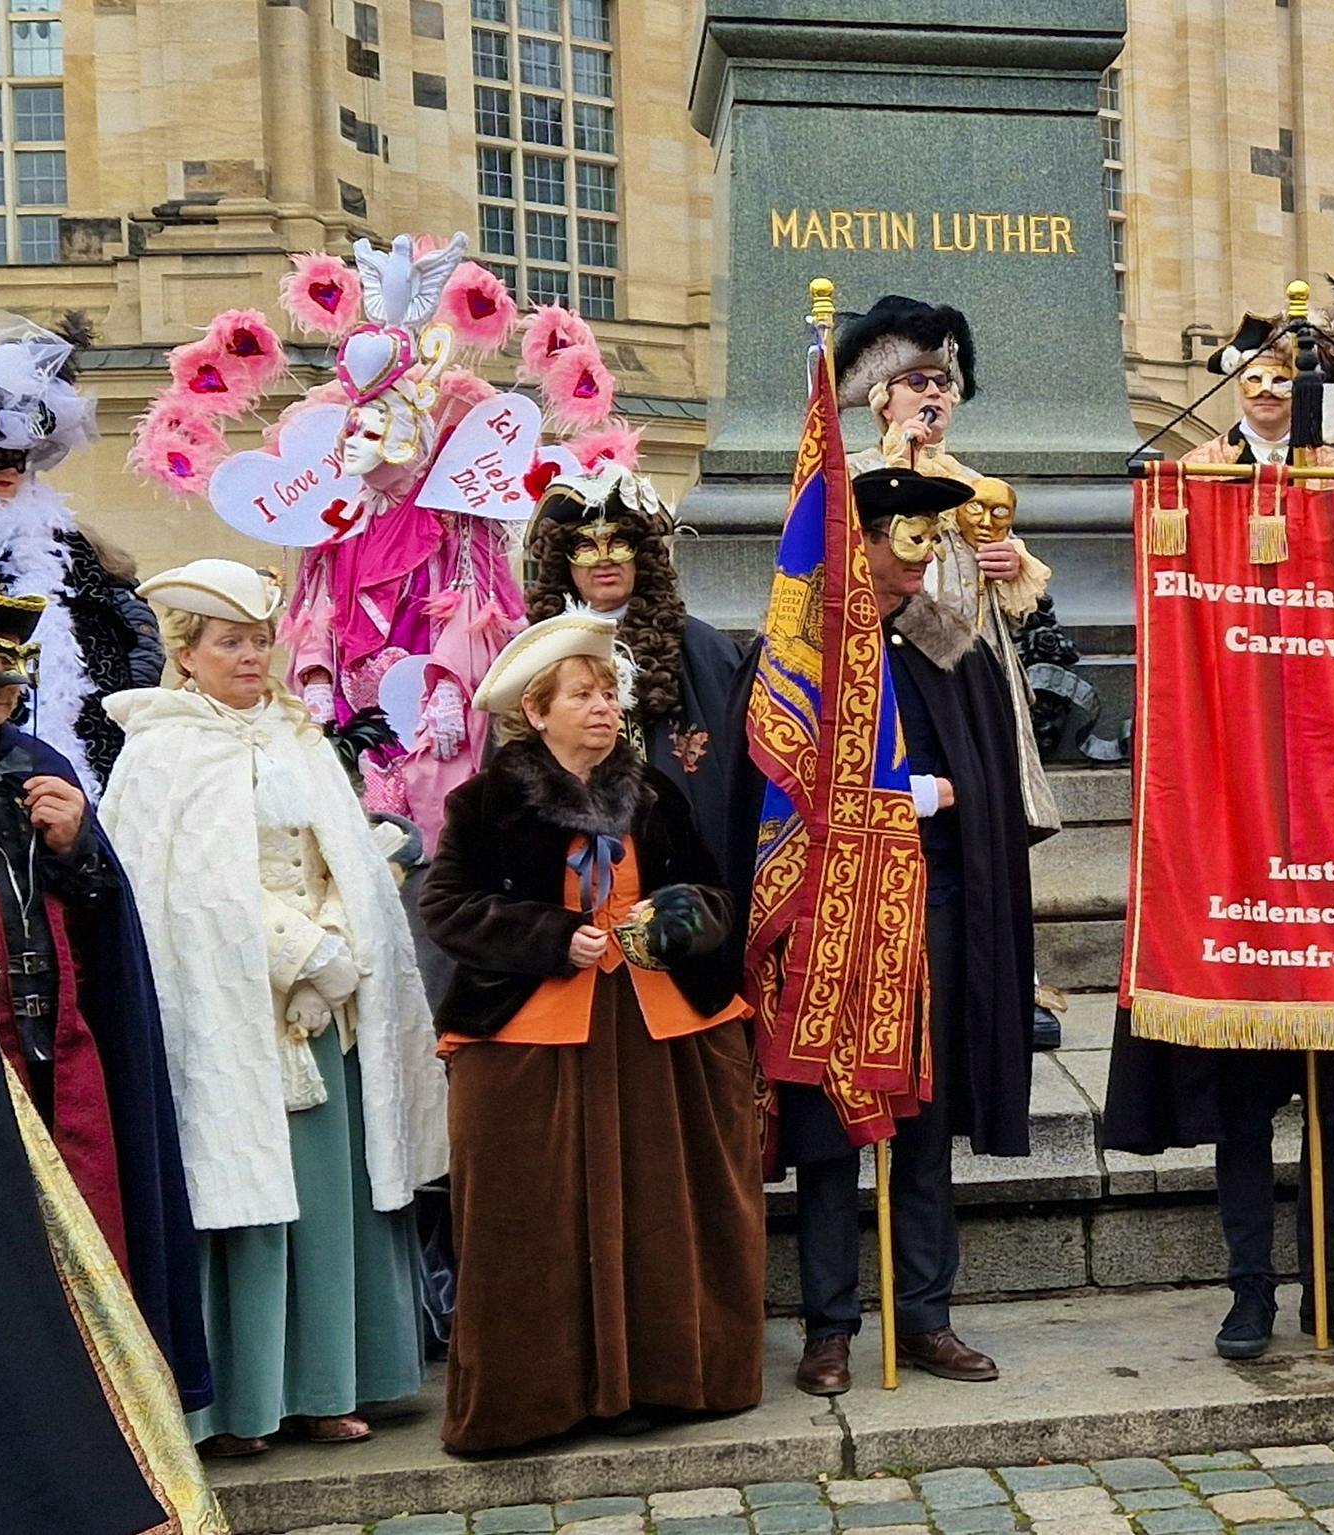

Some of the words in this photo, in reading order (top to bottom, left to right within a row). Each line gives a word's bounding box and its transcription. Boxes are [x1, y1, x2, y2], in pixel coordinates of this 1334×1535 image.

[770, 207, 915, 251] MARTIN
[932, 211, 1076, 254] LUTHER
[486, 408, 522, 446] Ich
[253, 496, 278, 523] I
[273, 469, 319, 507] love
[449, 468, 491, 508] Dich
